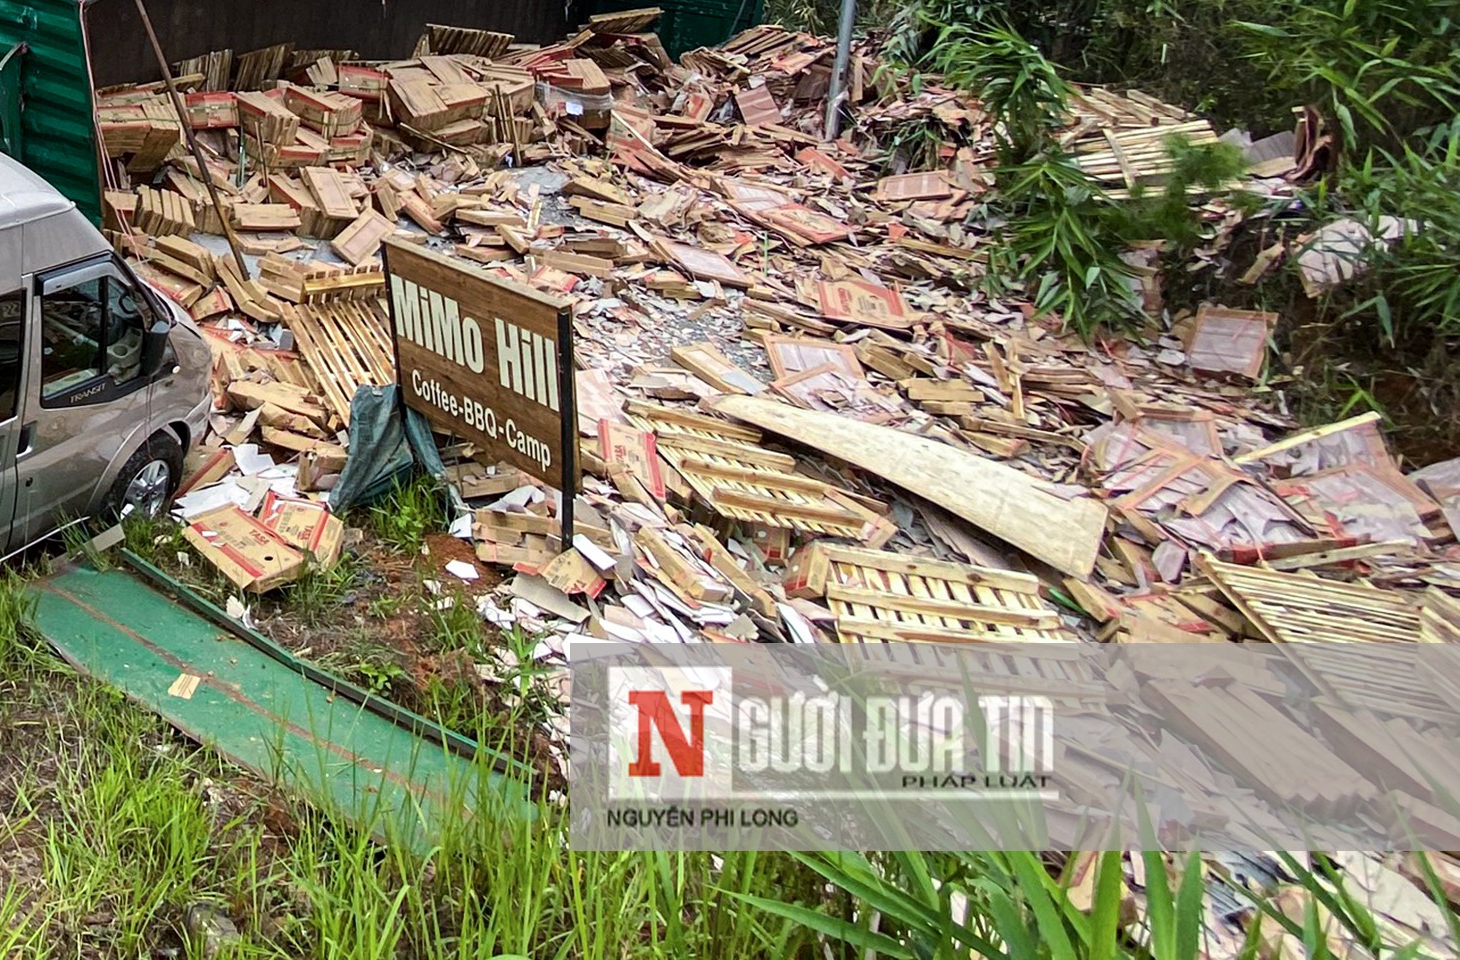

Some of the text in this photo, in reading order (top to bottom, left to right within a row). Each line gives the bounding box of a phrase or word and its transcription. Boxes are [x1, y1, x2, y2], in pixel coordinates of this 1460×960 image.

[390, 274, 560, 412] MiMo Hill
[70, 383, 107, 403] TRANSIT
